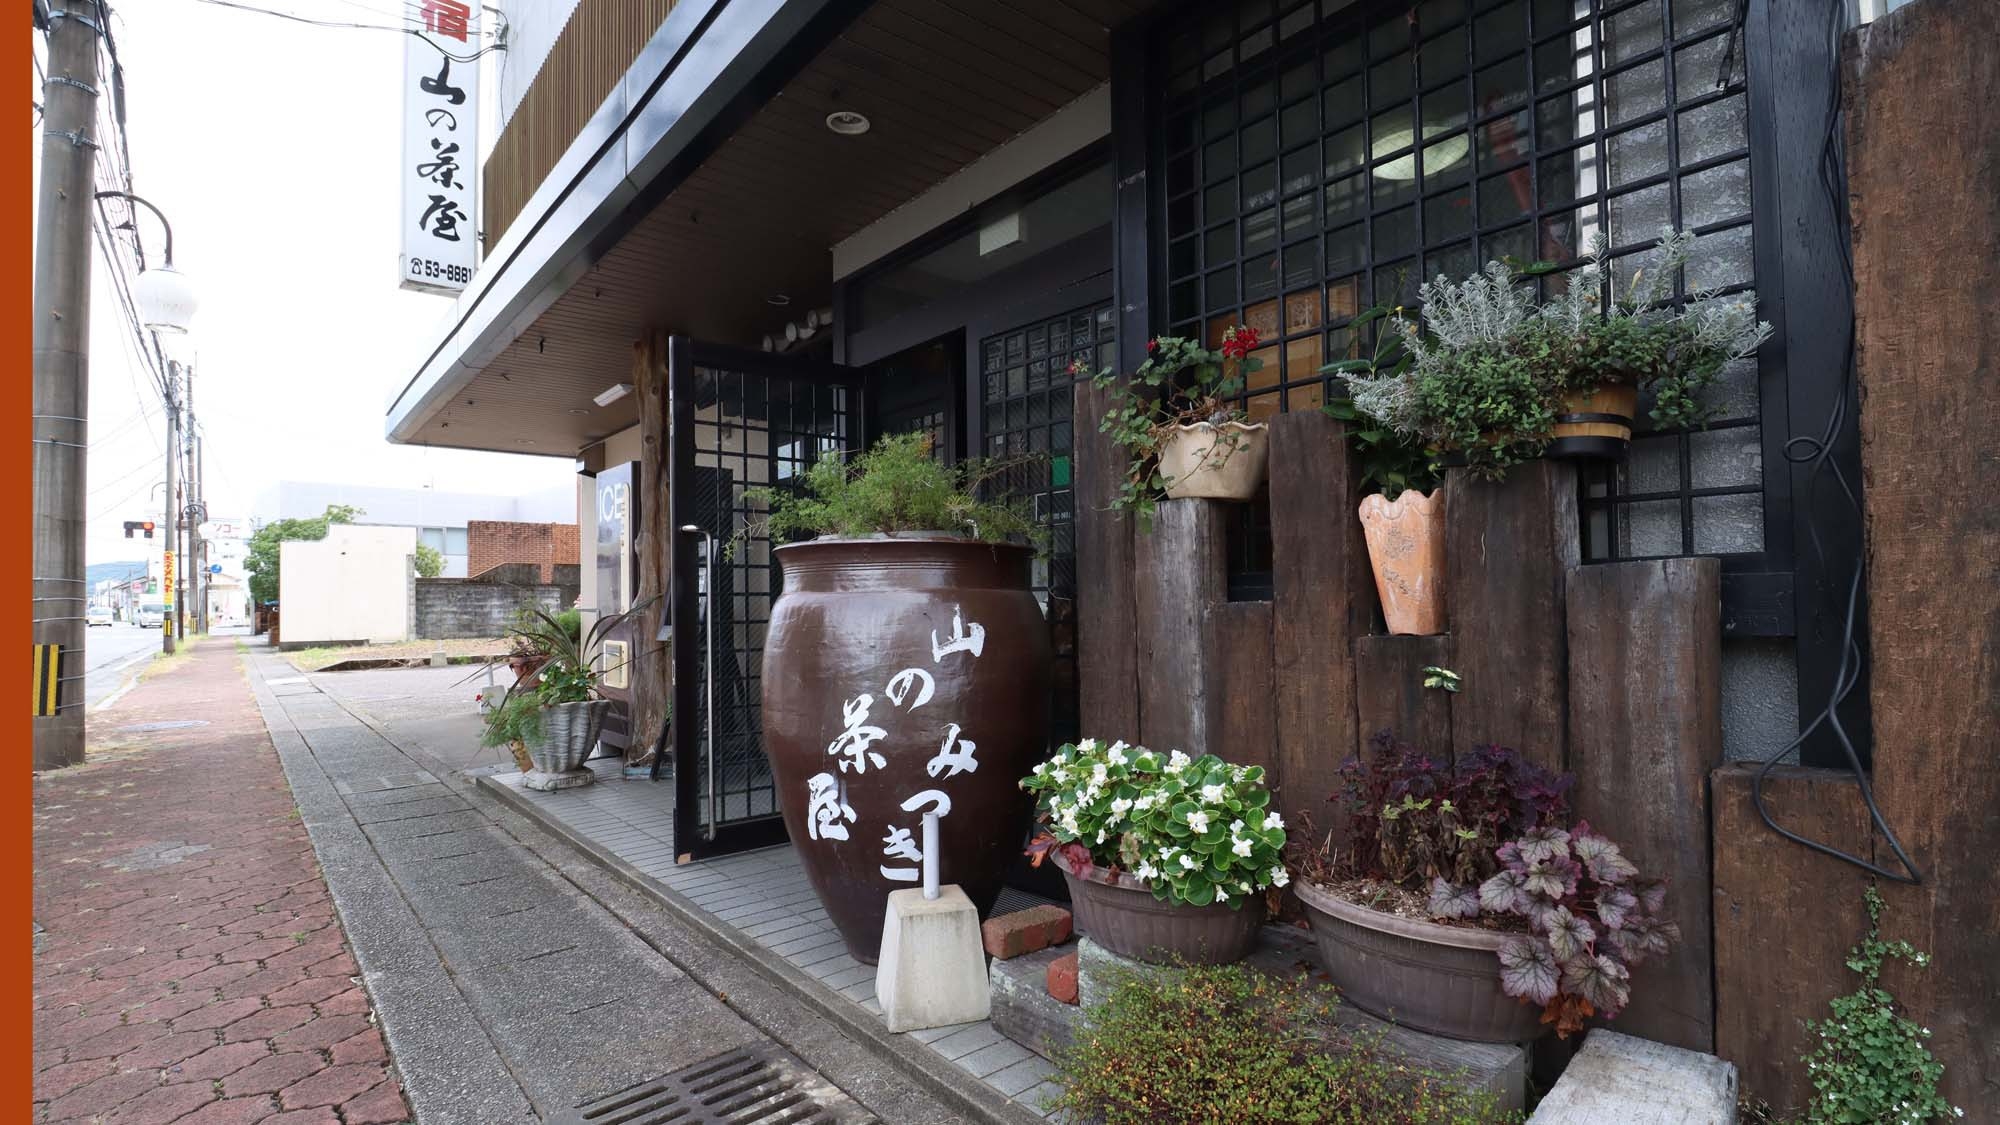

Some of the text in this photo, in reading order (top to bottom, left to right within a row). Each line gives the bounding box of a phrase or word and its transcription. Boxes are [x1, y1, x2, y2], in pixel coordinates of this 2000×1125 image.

[416, 55, 467, 242] 山の茶屋
[425, 259, 472, 284] 53-8881
[807, 603, 986, 841] 山の茶屋
